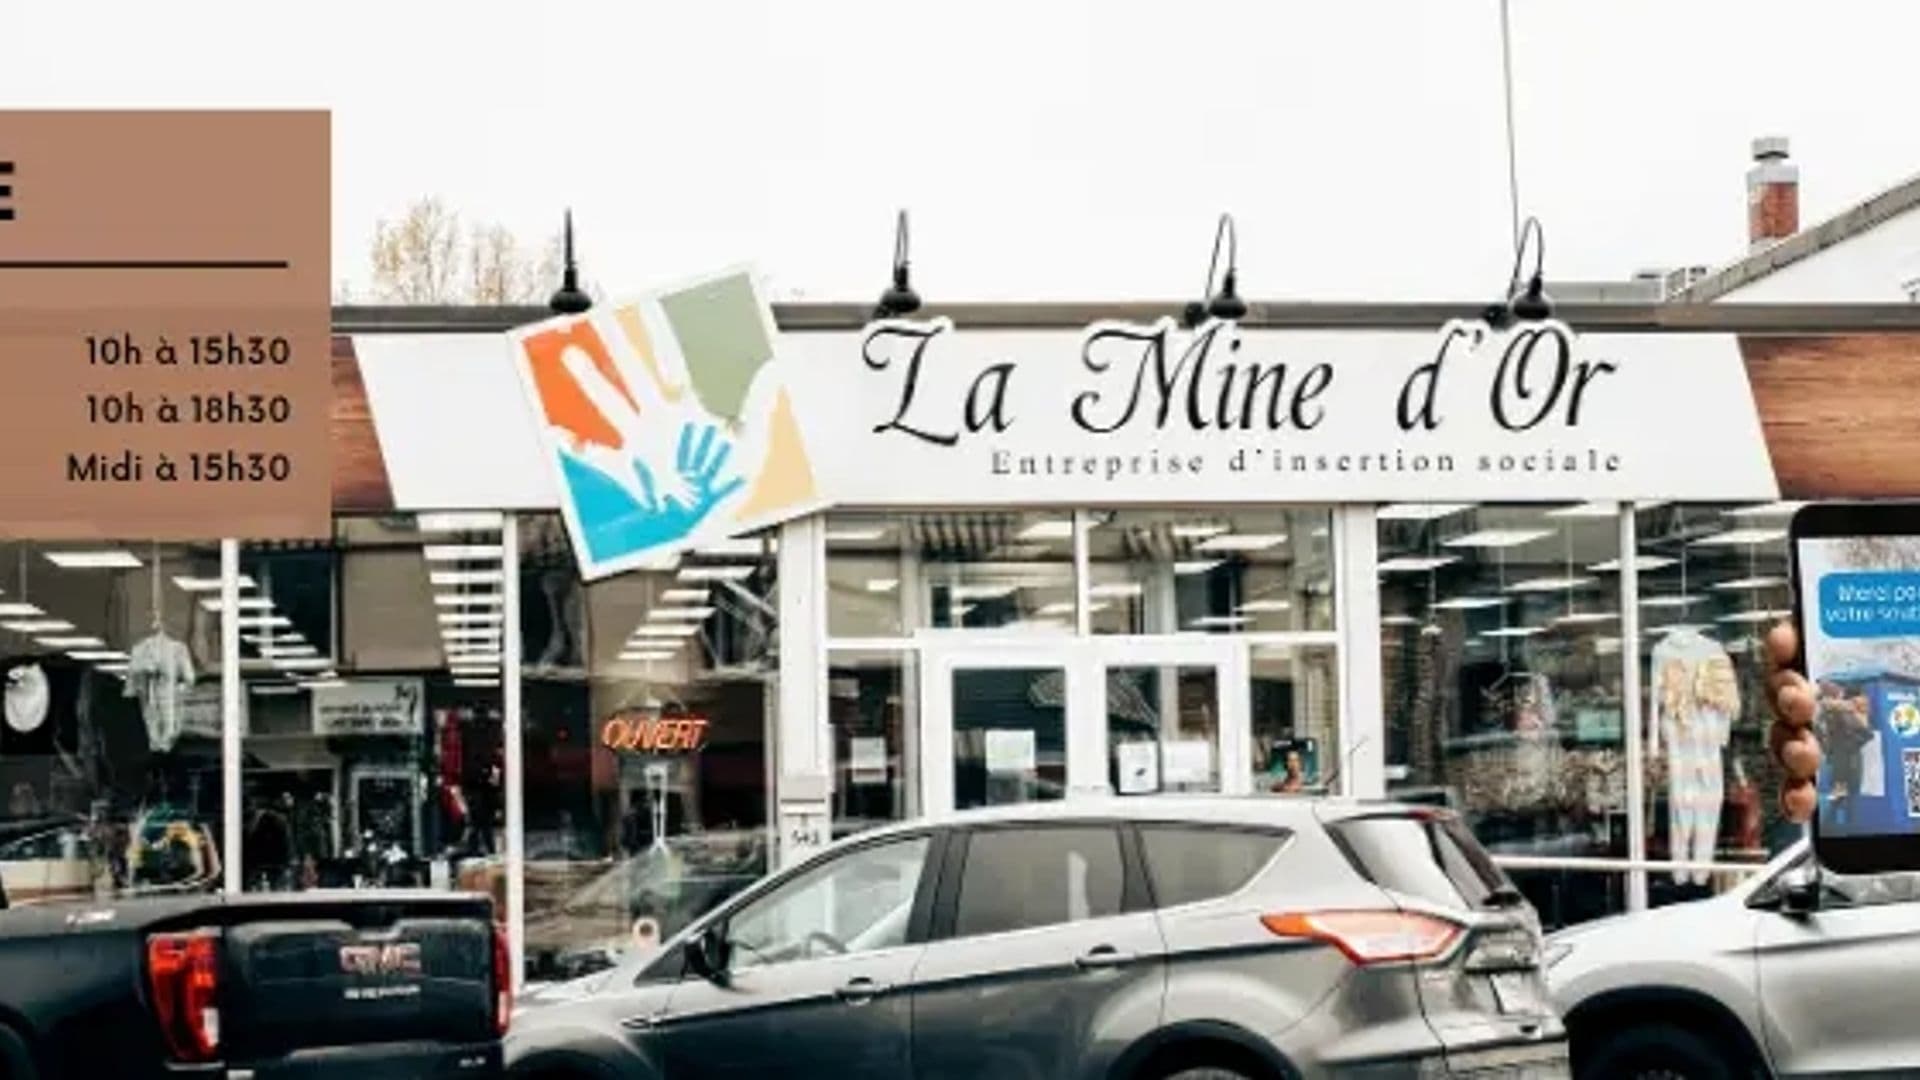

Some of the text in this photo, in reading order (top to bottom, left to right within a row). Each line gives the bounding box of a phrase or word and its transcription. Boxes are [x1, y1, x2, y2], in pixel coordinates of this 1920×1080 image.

[862, 322, 1617, 446] La Mine d'Or
[991, 449, 1622, 480] Entreprise d'insertion sociale
[603, 718, 708, 750] OUVERT
